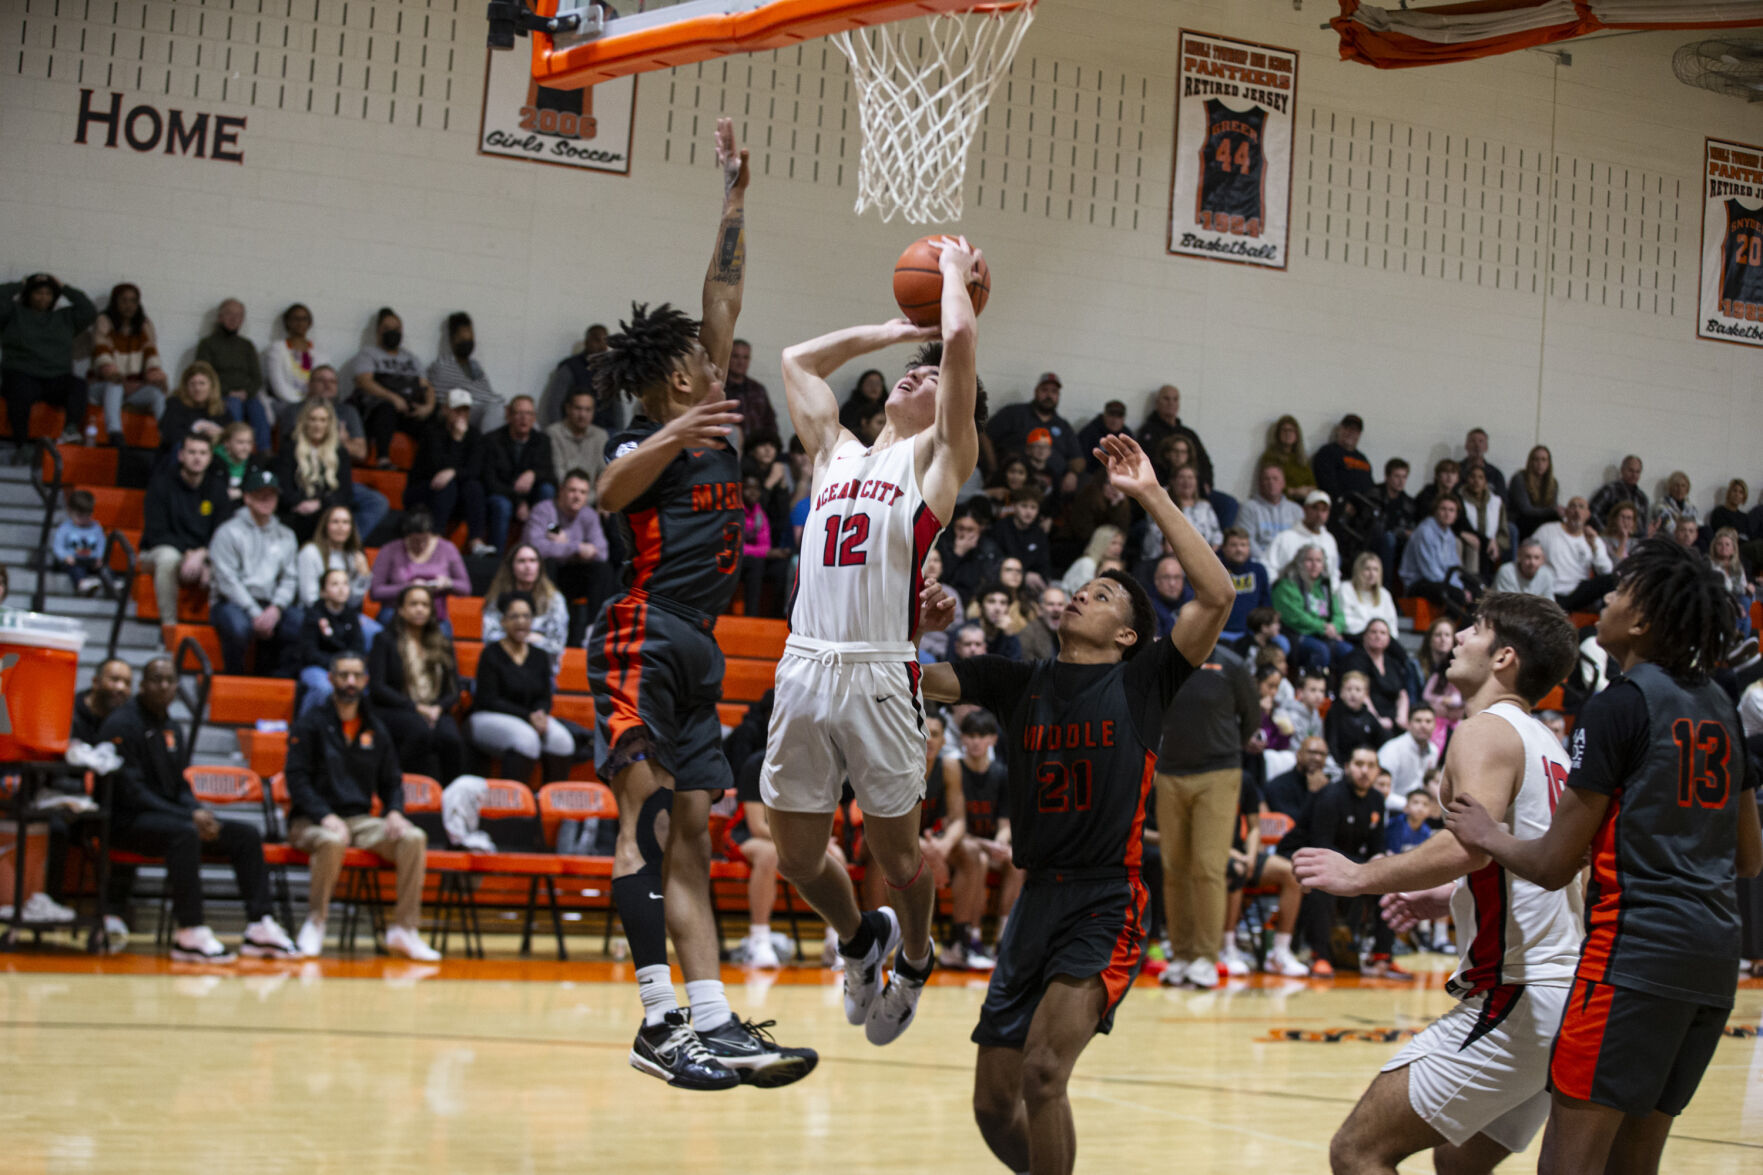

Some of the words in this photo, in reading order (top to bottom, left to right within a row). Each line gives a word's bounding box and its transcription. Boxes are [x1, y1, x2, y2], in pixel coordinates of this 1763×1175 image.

[1184, 56, 1291, 90] PANTHERS
[1184, 76, 1239, 97] RETIRED
[1242, 86, 1289, 115] JERSEY
[74, 88, 247, 165] HOME
[519, 106, 597, 140] 2006
[486, 130, 544, 153] Girls
[550, 140, 626, 163] Soccer
[1216, 138, 1250, 175] 44
[1710, 179, 1752, 198] RETIRED
[1731, 217, 1763, 233] SNYDE
[1180, 232, 1277, 260] Basketball
[1736, 234, 1761, 266] 20
[859, 479, 904, 507] CITY
[716, 522, 742, 575] 3
[823, 512, 870, 567] 12
[1024, 719, 1114, 752] MIDDLE
[1672, 717, 1731, 809] 13
[1036, 759, 1092, 813] 21
